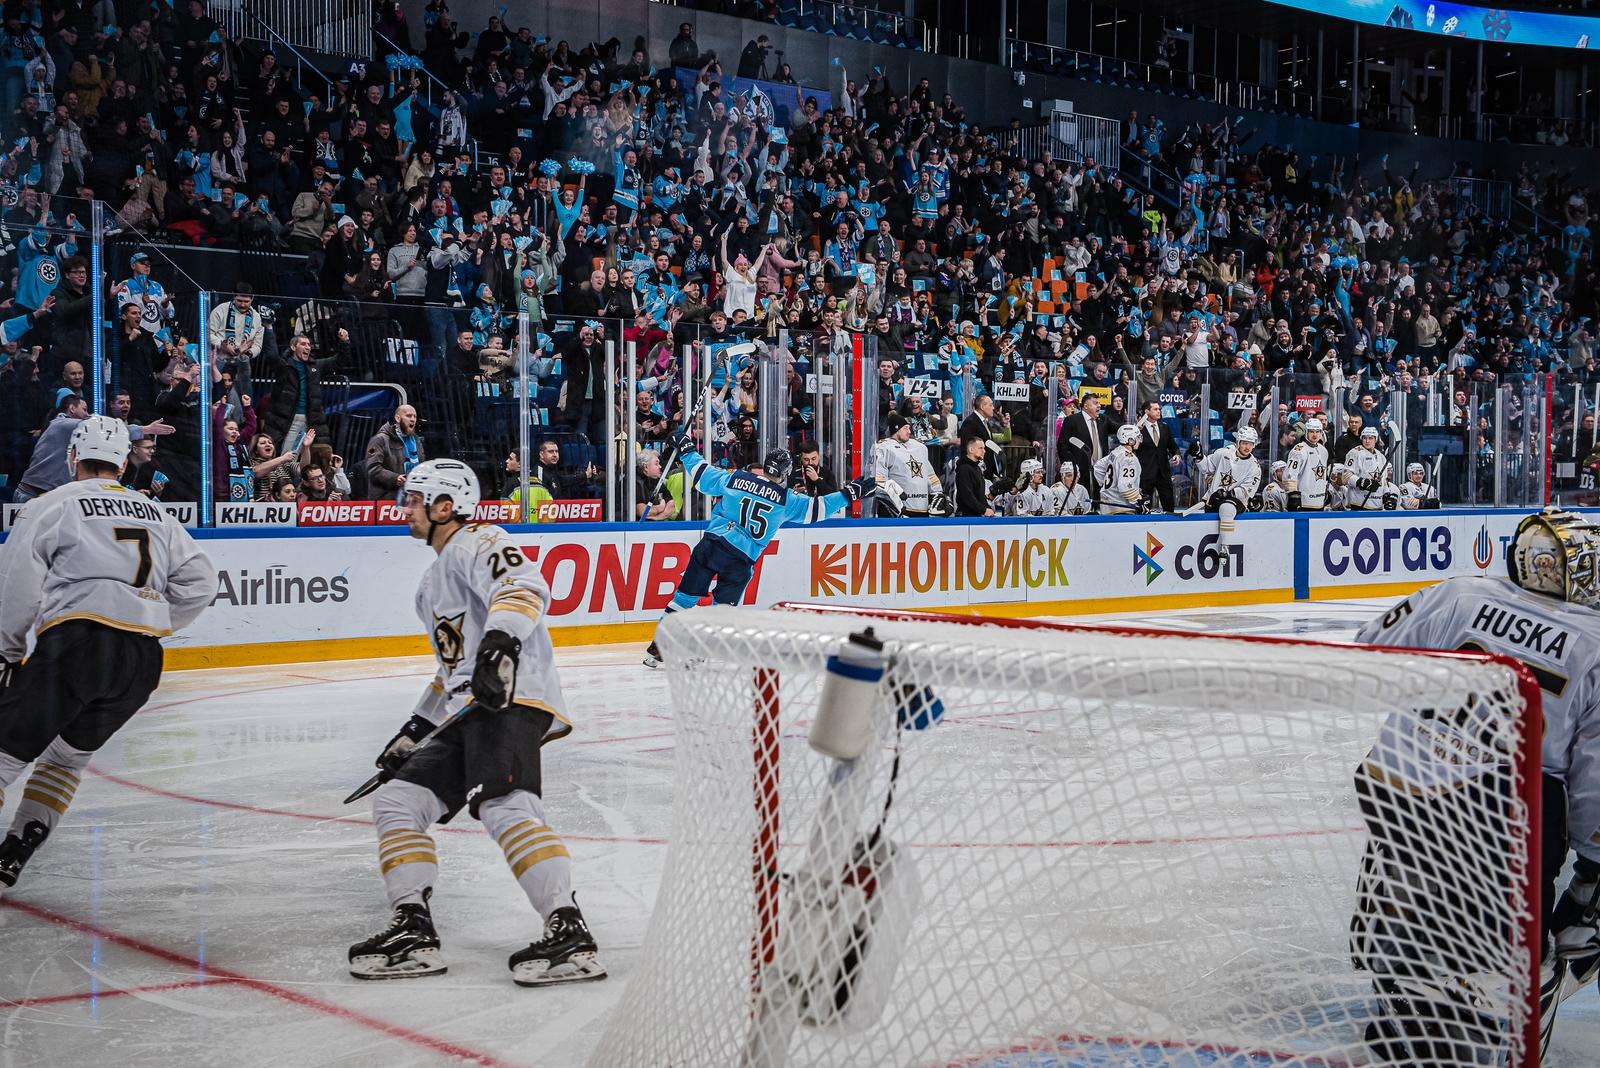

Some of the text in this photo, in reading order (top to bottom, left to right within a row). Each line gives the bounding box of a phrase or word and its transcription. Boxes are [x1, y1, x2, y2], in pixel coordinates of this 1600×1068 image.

[996, 386, 1028, 397] KHL.RU
[1296, 399, 1322, 408] FONBET
[105, 430, 112, 441] 7
[1122, 468, 1135, 478] 23
[78, 498, 163, 523] DERYABIN
[221, 507, 291, 524] KHL.RU
[300, 505, 374, 523] FONBET
[467, 504, 520, 521] NBET
[538, 503, 601, 520] FONBET
[739, 497, 774, 541] 15
[113, 527, 152, 588] 7
[487, 546, 523, 580] 26
[810, 538, 1070, 597] КИНОПОИСК
[208, 568, 350, 607] Airlines
[1471, 603, 1569, 660] HUSKA
